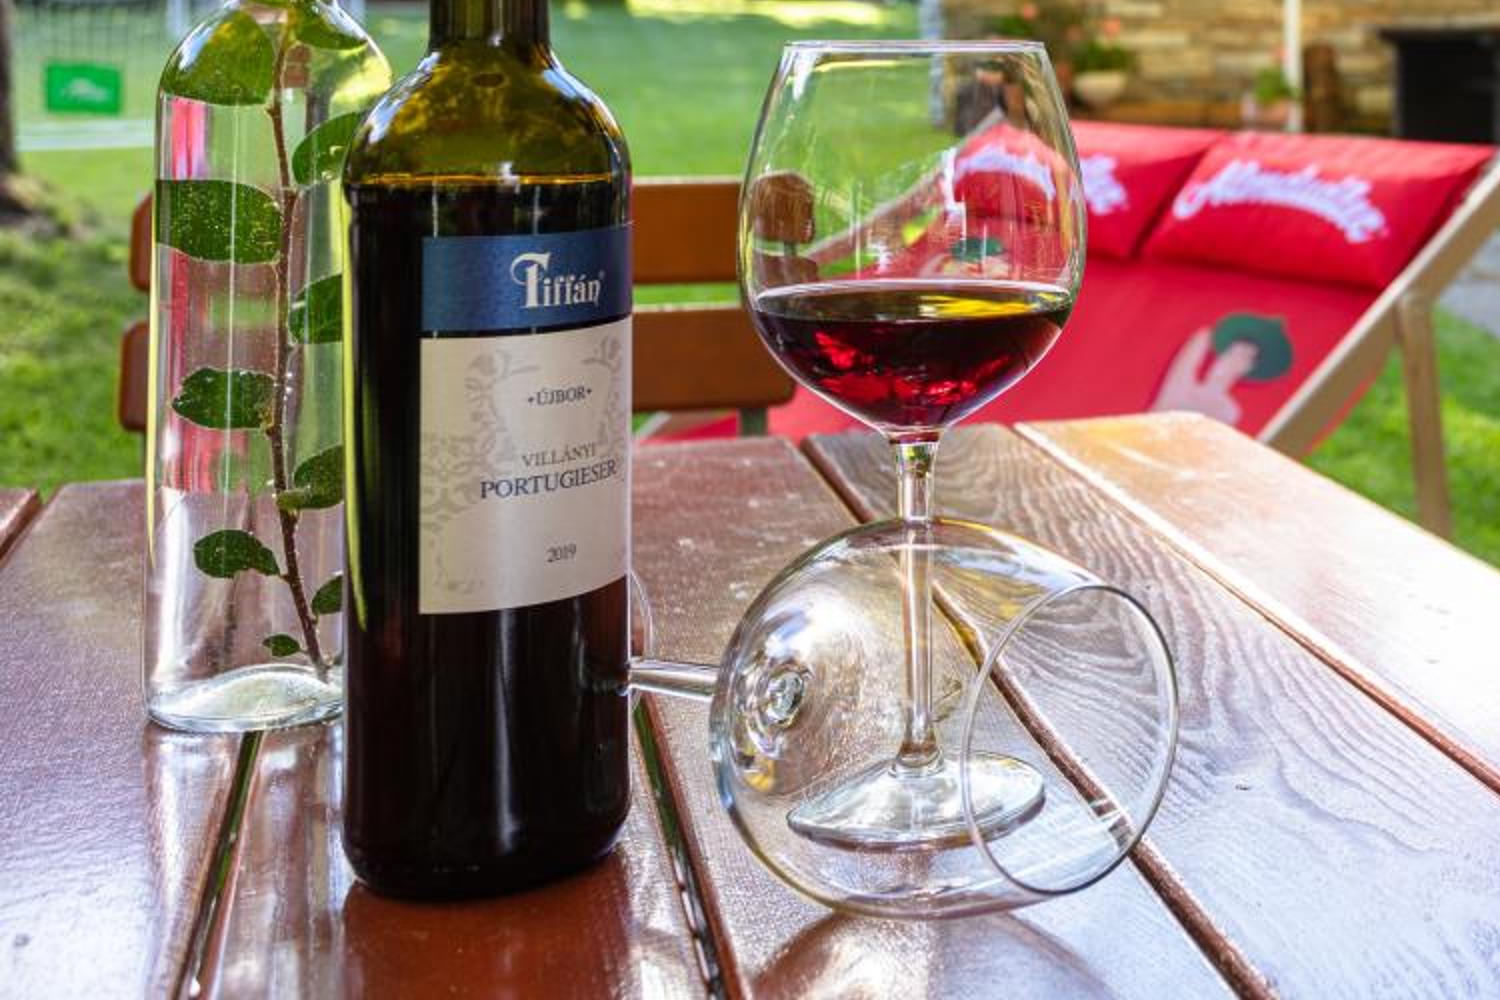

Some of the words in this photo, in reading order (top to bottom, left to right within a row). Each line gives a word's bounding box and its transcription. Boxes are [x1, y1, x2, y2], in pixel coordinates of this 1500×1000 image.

[510, 252, 600, 308] Tiffán
[521, 442, 597, 467] VILLÁNYI
[480, 459, 617, 499] PORTUGIESER
[547, 543, 577, 563] 2019
